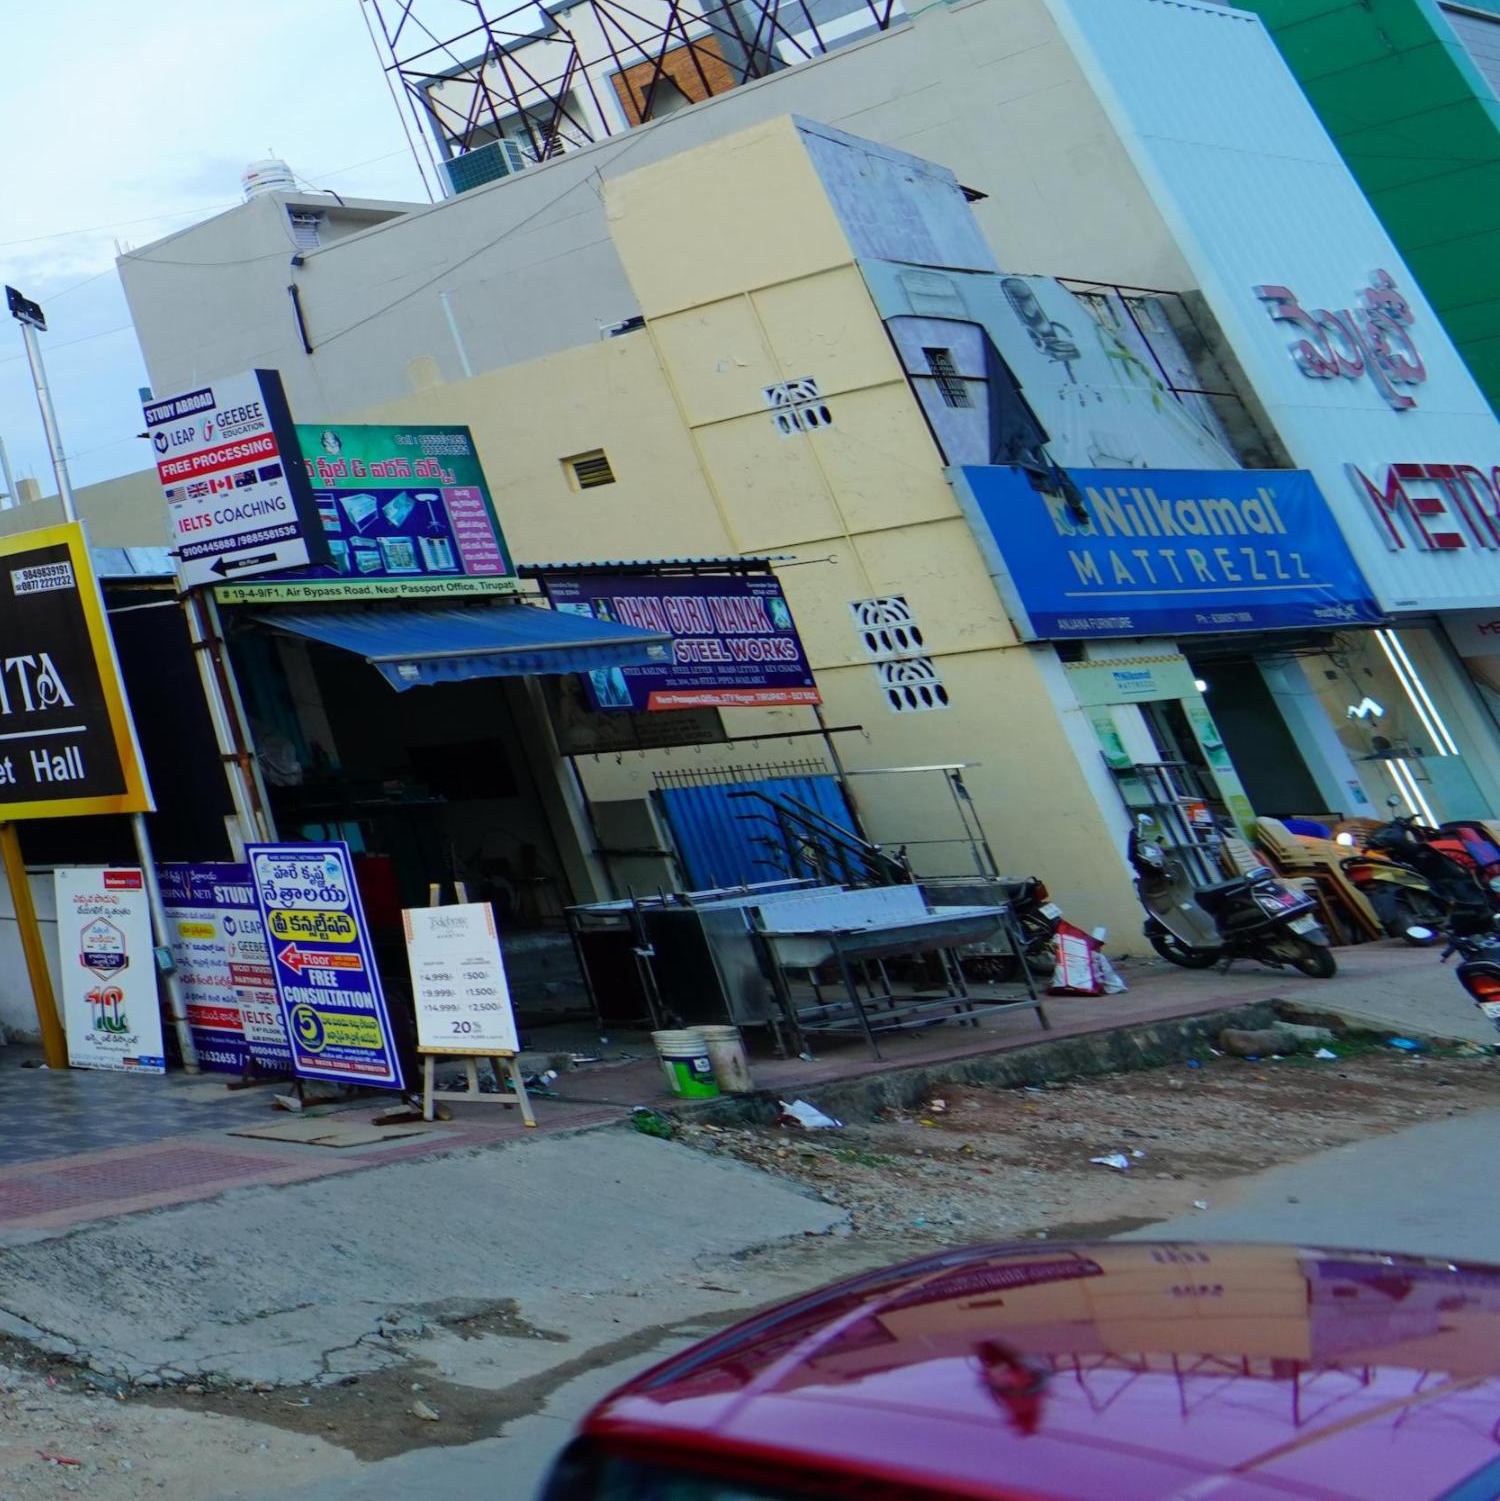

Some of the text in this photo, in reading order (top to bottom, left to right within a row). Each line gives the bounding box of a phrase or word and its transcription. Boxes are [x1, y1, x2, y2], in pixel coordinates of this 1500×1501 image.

[146, 392, 213, 424] STUDY ABROAD
[170, 402, 263, 447] LEAP GEEBEE
[223, 422, 265, 439] EDUCATION
[162, 460, 192, 477] FREE
[193, 437, 274, 471] PROCESSING
[179, 495, 287, 533] IELTS COACHING
[1086, 487, 1288, 536] Nilkamal
[1342, 462, 1500, 552] METR
[183, 538, 236, 558] 9100445888
[22, 564, 69, 581] 9849839191
[1068, 548, 1311, 585] MATTREZZZ
[286, 586, 301, 597] Air
[303, 586, 342, 598] Bypass
[344, 585, 374, 597] Road,
[375, 585, 399, 595] Near
[401, 583, 445, 596] Passport
[446, 582, 478, 594] Office,
[480, 579, 515, 592] Tirupati
[663, 595, 715, 635] GURU
[707, 595, 775, 635] NANAK
[1092, 615, 1135, 630] FURNITURE
[673, 637, 800, 664] STEEL WORKS
[30, 746, 85, 783] Hall
[214, 885, 254, 905] STUDY
[239, 920, 261, 933] LEAP
[302, 954, 331, 966] Floor
[308, 968, 339, 988] FREE
[283, 985, 375, 1010] CONSULTATION
[242, 1010, 273, 1025] IELTS
[298, 1010, 318, 1040] 5
[451, 1020, 471, 1034] 20
